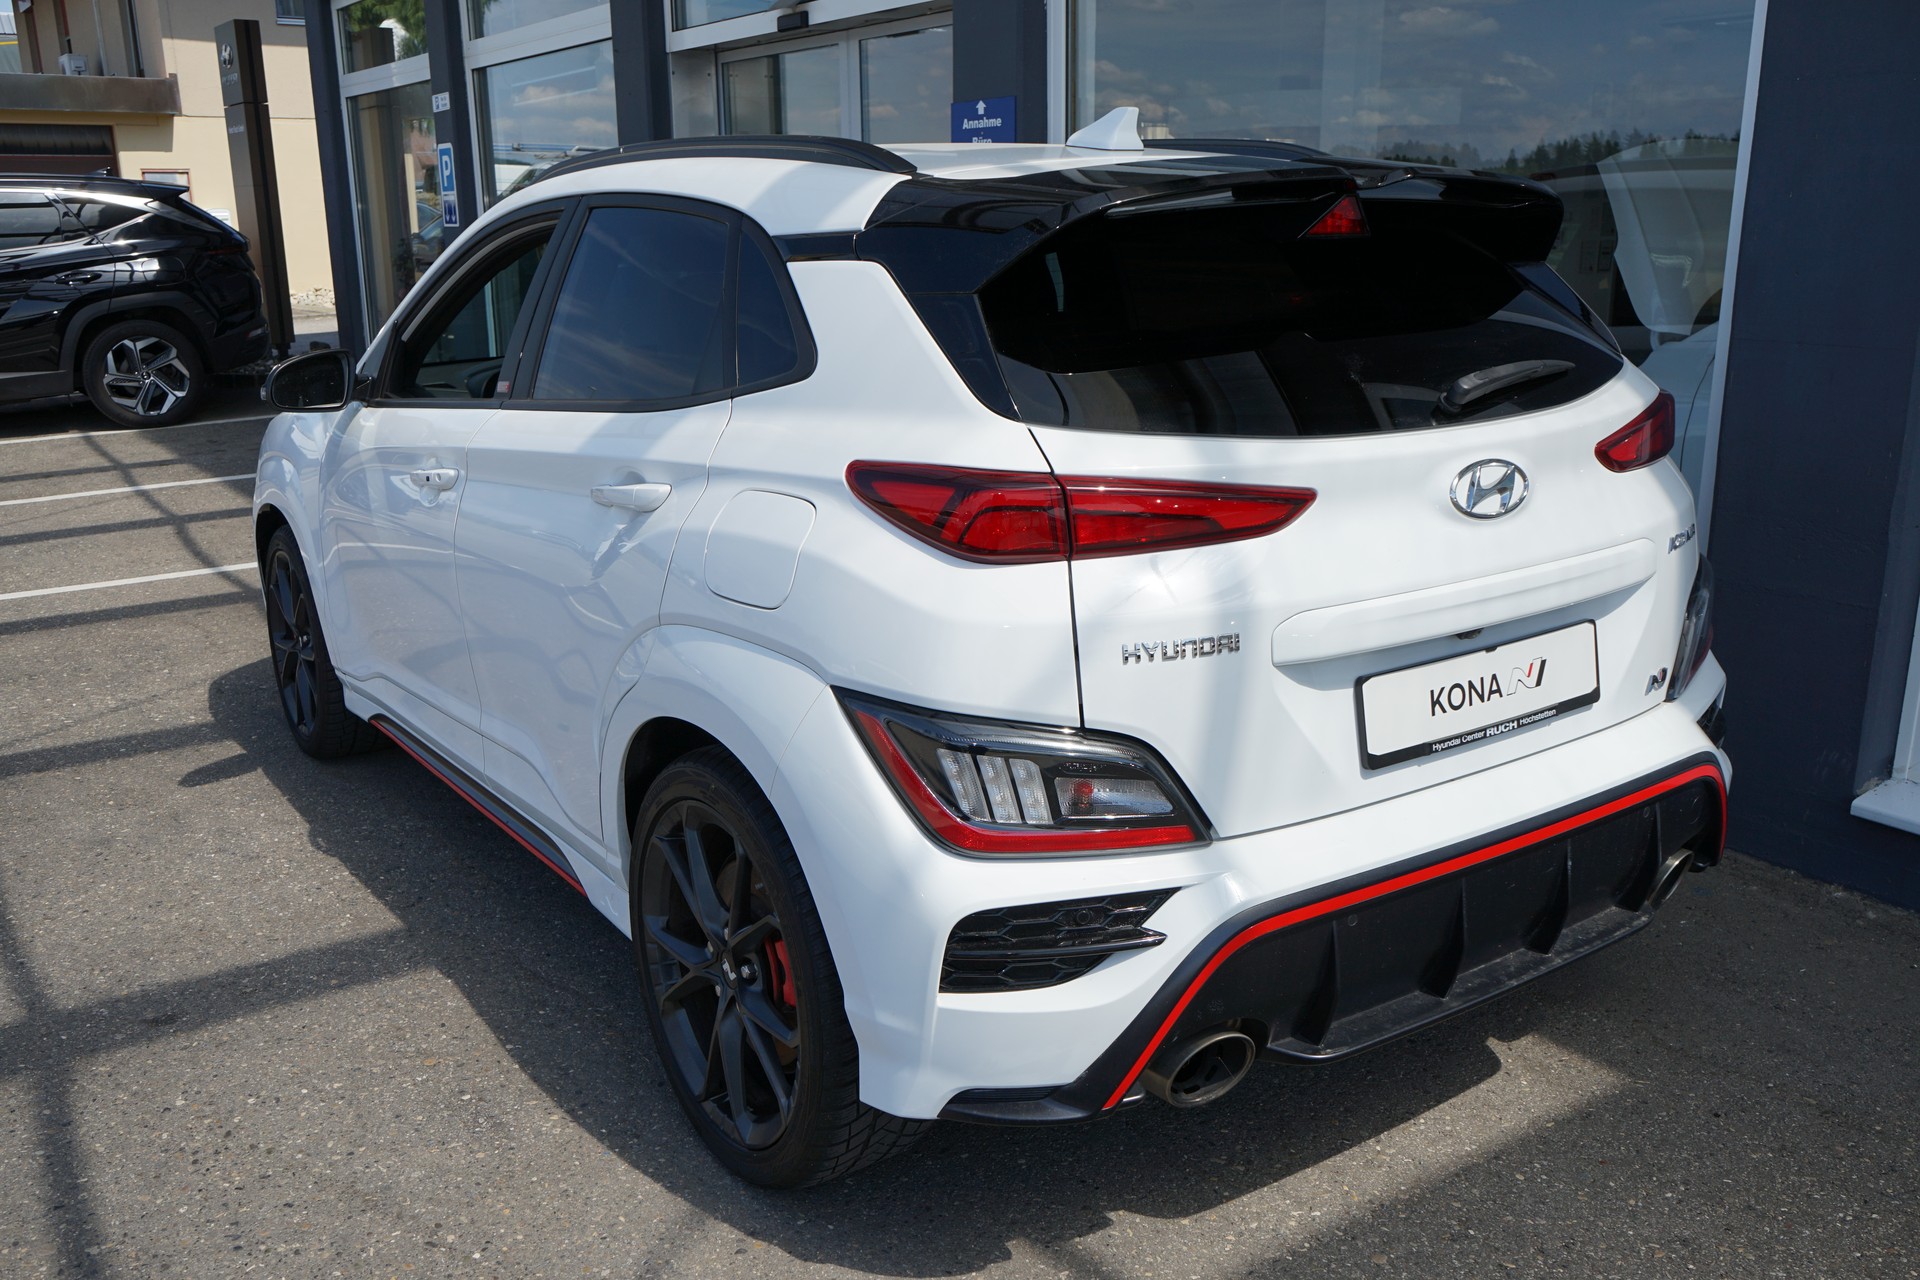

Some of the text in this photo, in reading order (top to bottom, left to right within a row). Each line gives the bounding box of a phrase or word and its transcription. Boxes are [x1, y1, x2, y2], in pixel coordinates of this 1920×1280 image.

[962, 117, 1002, 130] Annahme
[442, 154, 451, 187] P
[1121, 632, 1240, 665] HYUNDAI
[1430, 673, 1504, 717] KONA
[1432, 738, 1461, 752] Hyundai
[1462, 730, 1485, 743] Center
[1486, 720, 1518, 737] RUCH
